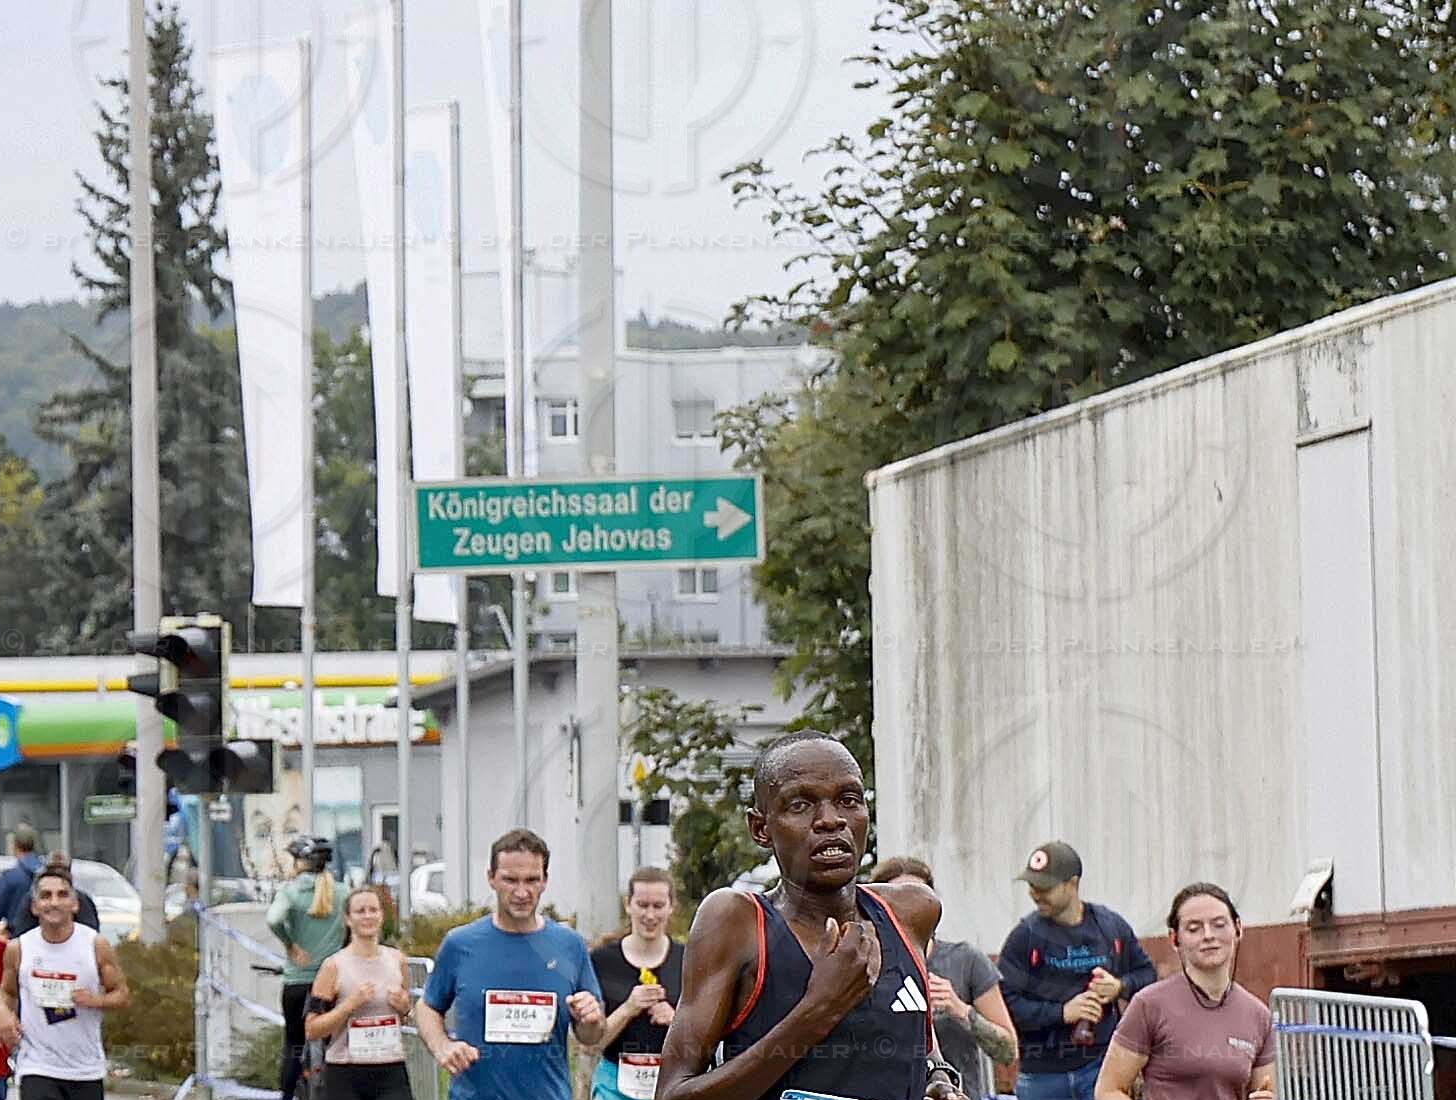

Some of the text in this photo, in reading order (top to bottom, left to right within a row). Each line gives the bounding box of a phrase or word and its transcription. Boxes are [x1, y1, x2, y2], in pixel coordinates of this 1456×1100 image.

[428, 485, 693, 524] Königreichssaal der
[452, 523, 673, 561] Zeugen Jehovas
